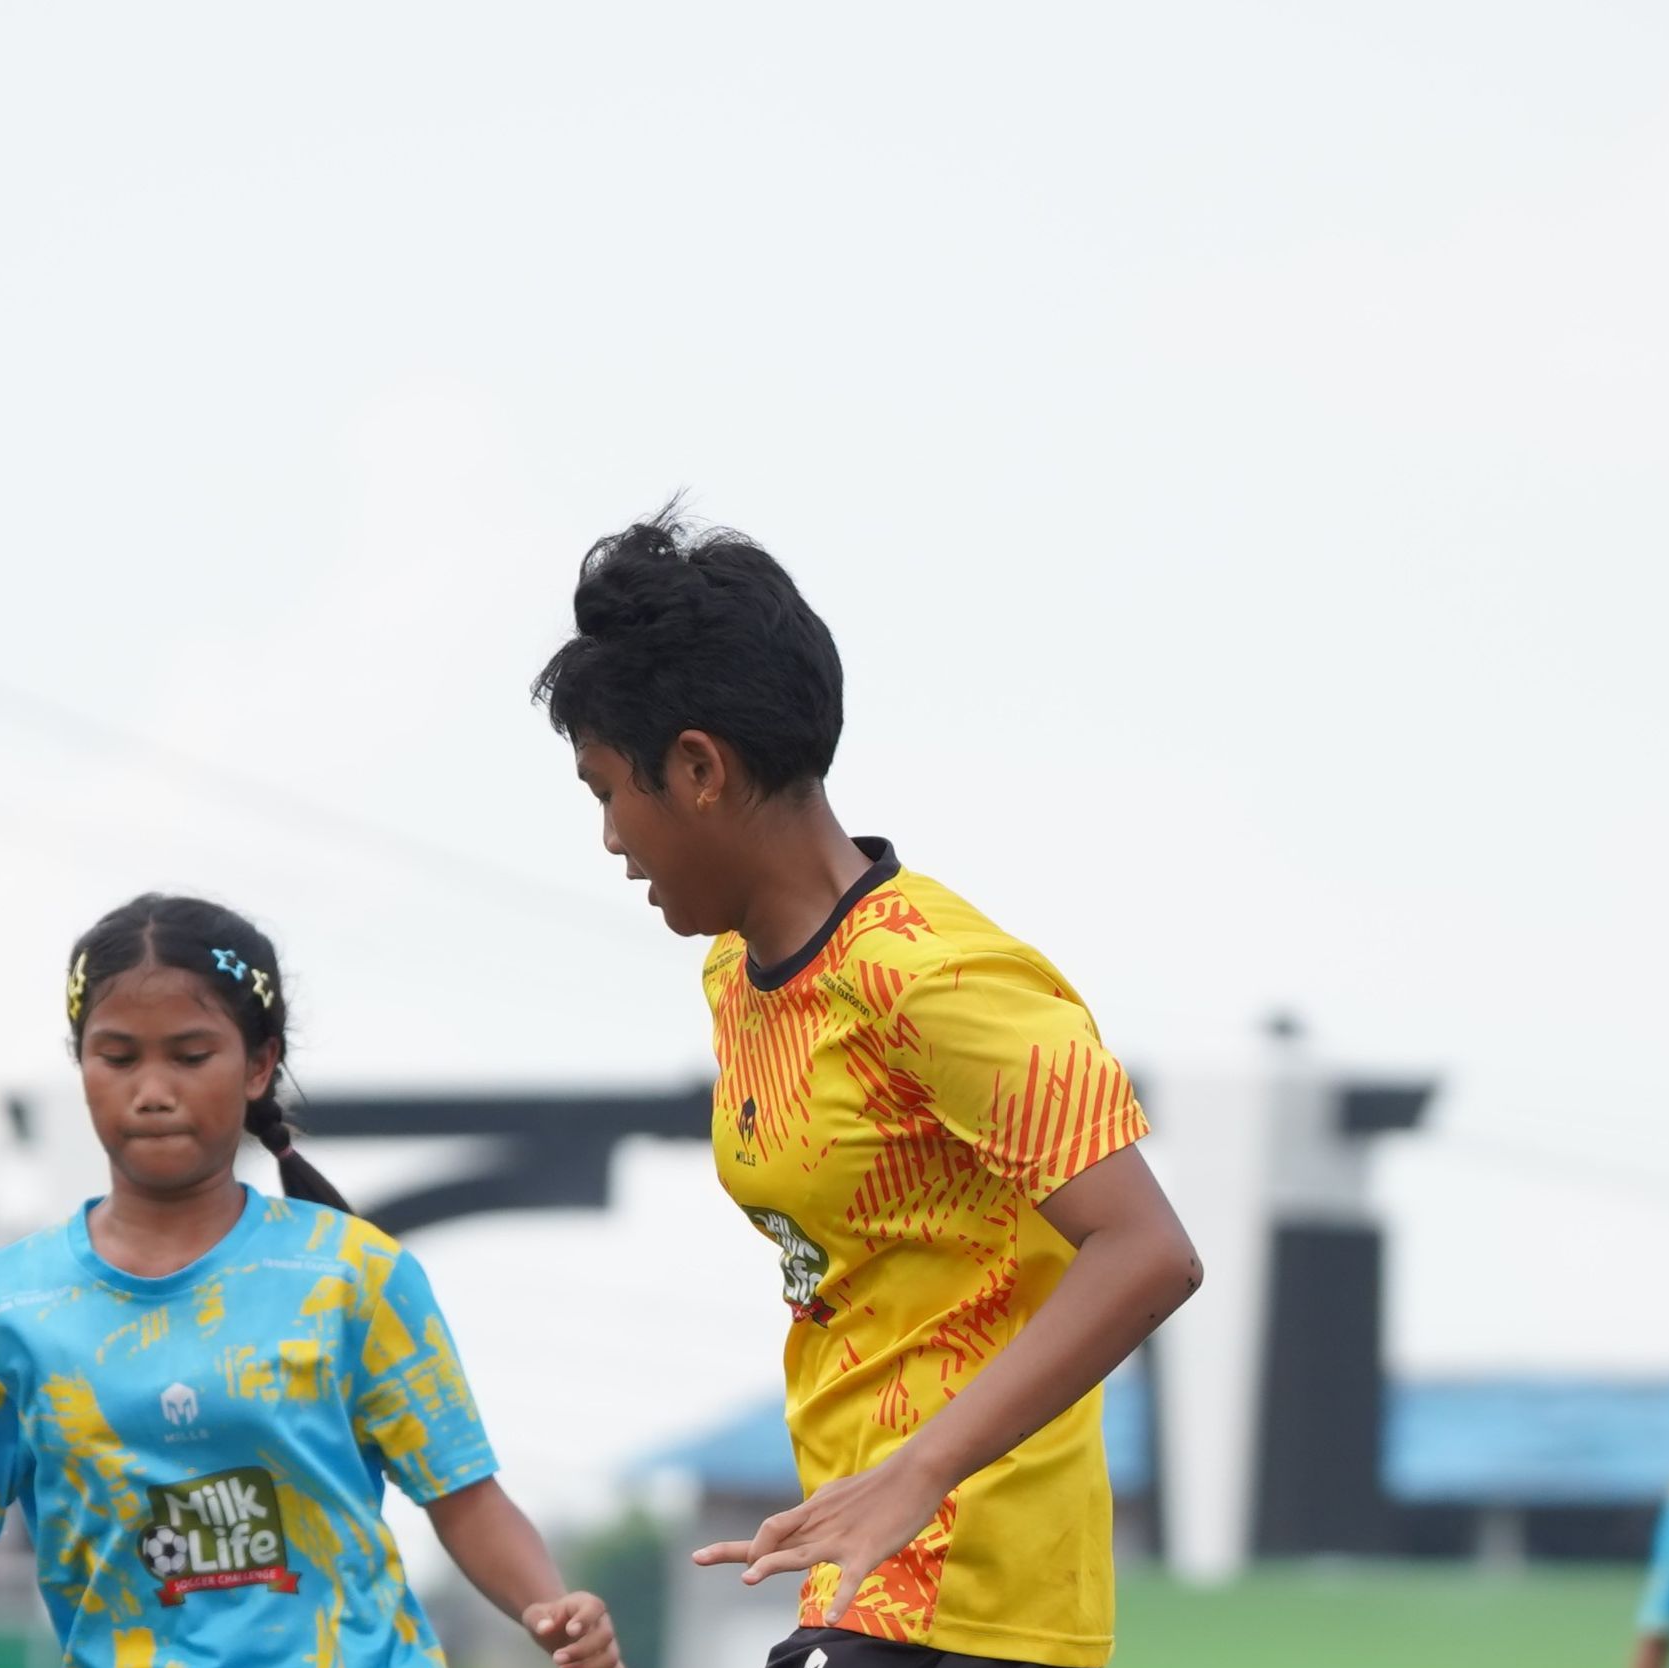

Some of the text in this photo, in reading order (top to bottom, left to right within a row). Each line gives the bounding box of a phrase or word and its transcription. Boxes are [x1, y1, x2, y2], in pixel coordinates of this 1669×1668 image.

[735, 1150, 756, 1167] MILLS
[164, 1476, 267, 1527] Milk
[187, 1523, 278, 1572] Life
[174, 1567, 277, 1592] SOCCER CHALLENGE
